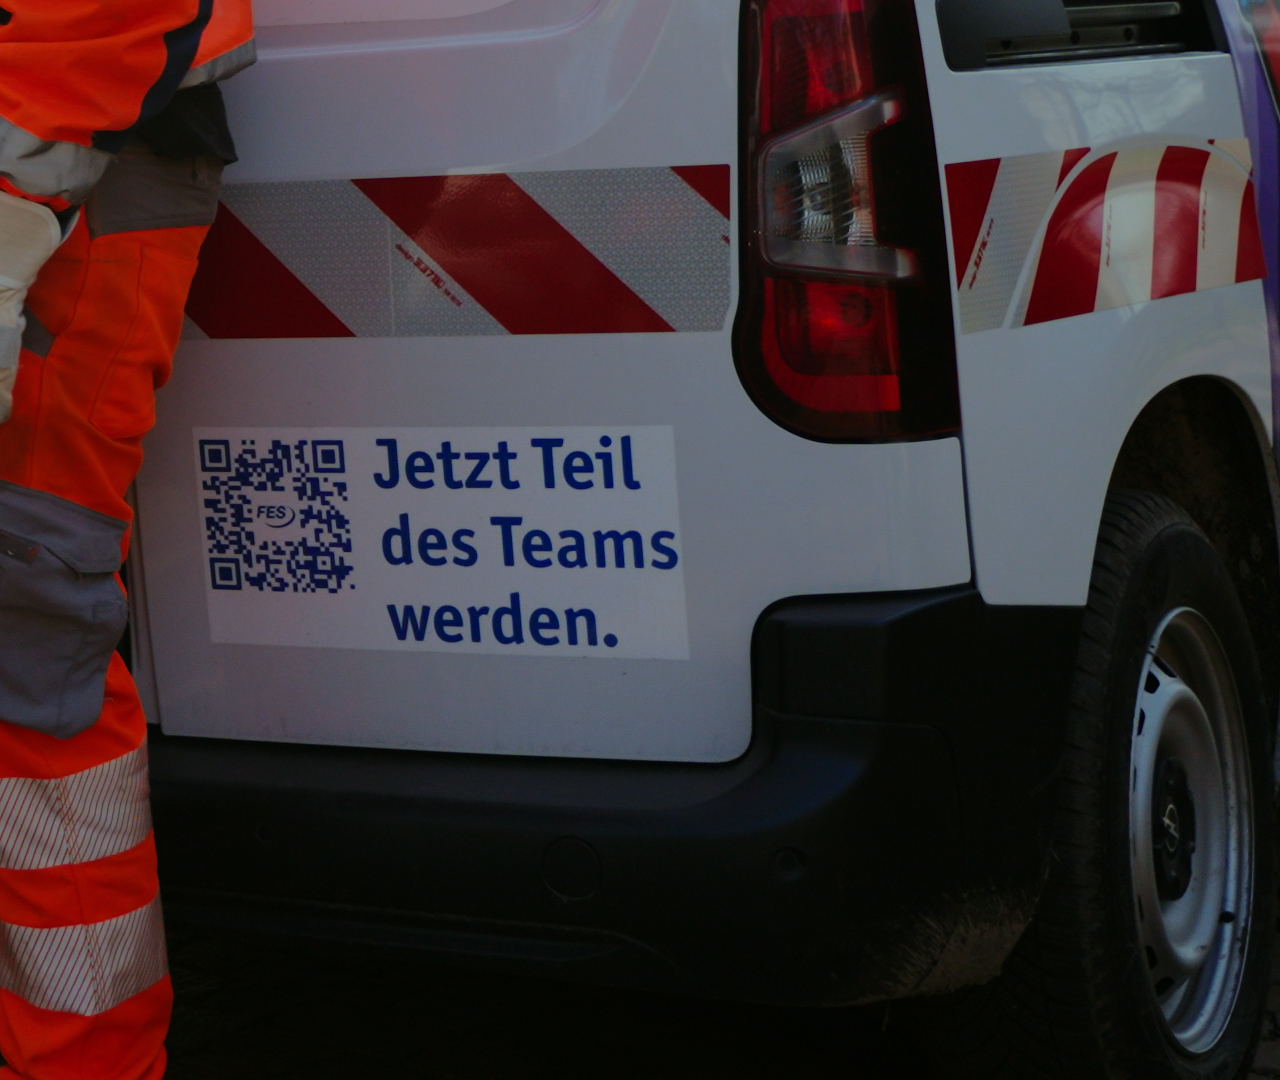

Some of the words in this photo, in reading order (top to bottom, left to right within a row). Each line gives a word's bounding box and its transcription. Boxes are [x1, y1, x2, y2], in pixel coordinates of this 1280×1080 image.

[373, 438, 520, 490] Jetzt
[530, 434, 642, 491] Teil
[257, 505, 286, 519] FES
[381, 513, 478, 567] des
[490, 516, 679, 570] Teams
[387, 592, 620, 648] werden.
